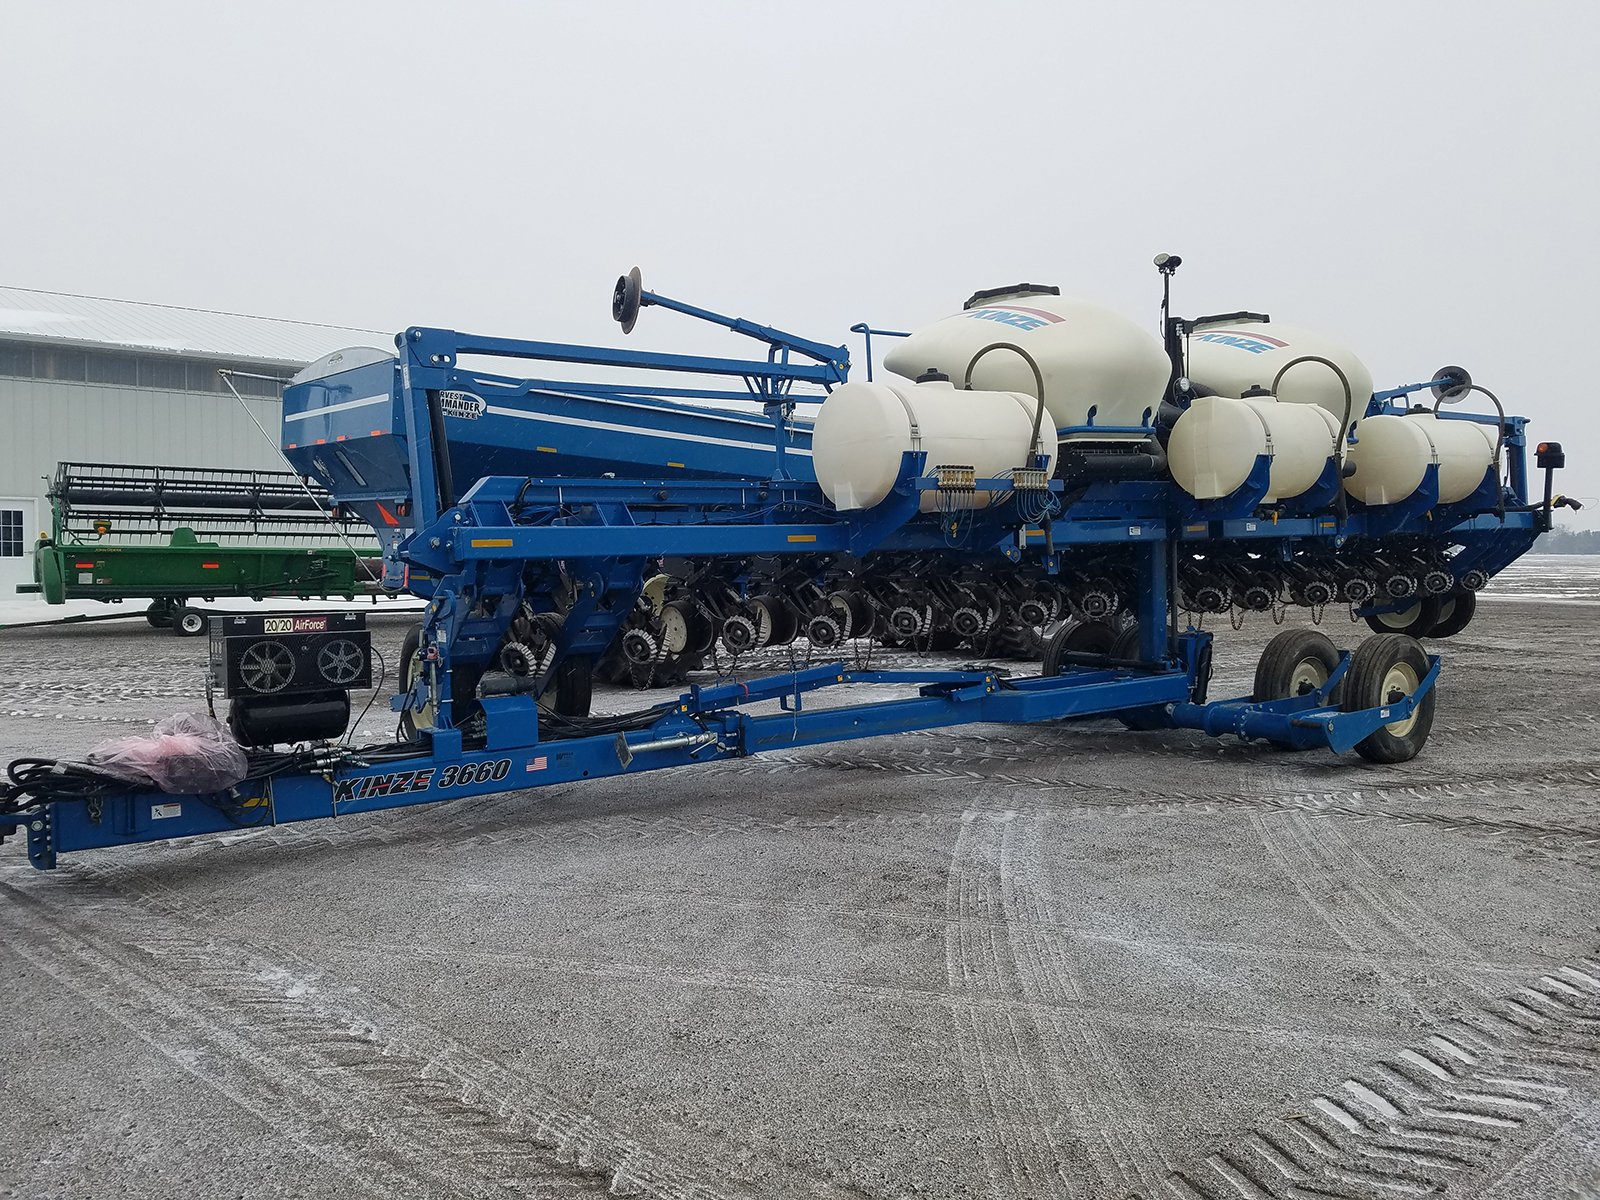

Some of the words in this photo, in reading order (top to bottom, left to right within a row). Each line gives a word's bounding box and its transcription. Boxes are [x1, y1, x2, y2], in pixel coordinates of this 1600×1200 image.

[967, 309, 1050, 331] KINZE
[1196, 334, 1275, 354] KINZE
[440, 391, 464, 400] RVEST
[265, 619, 292, 632] 20/20
[333, 768, 436, 804] KINZE
[437, 758, 512, 790] 3660
